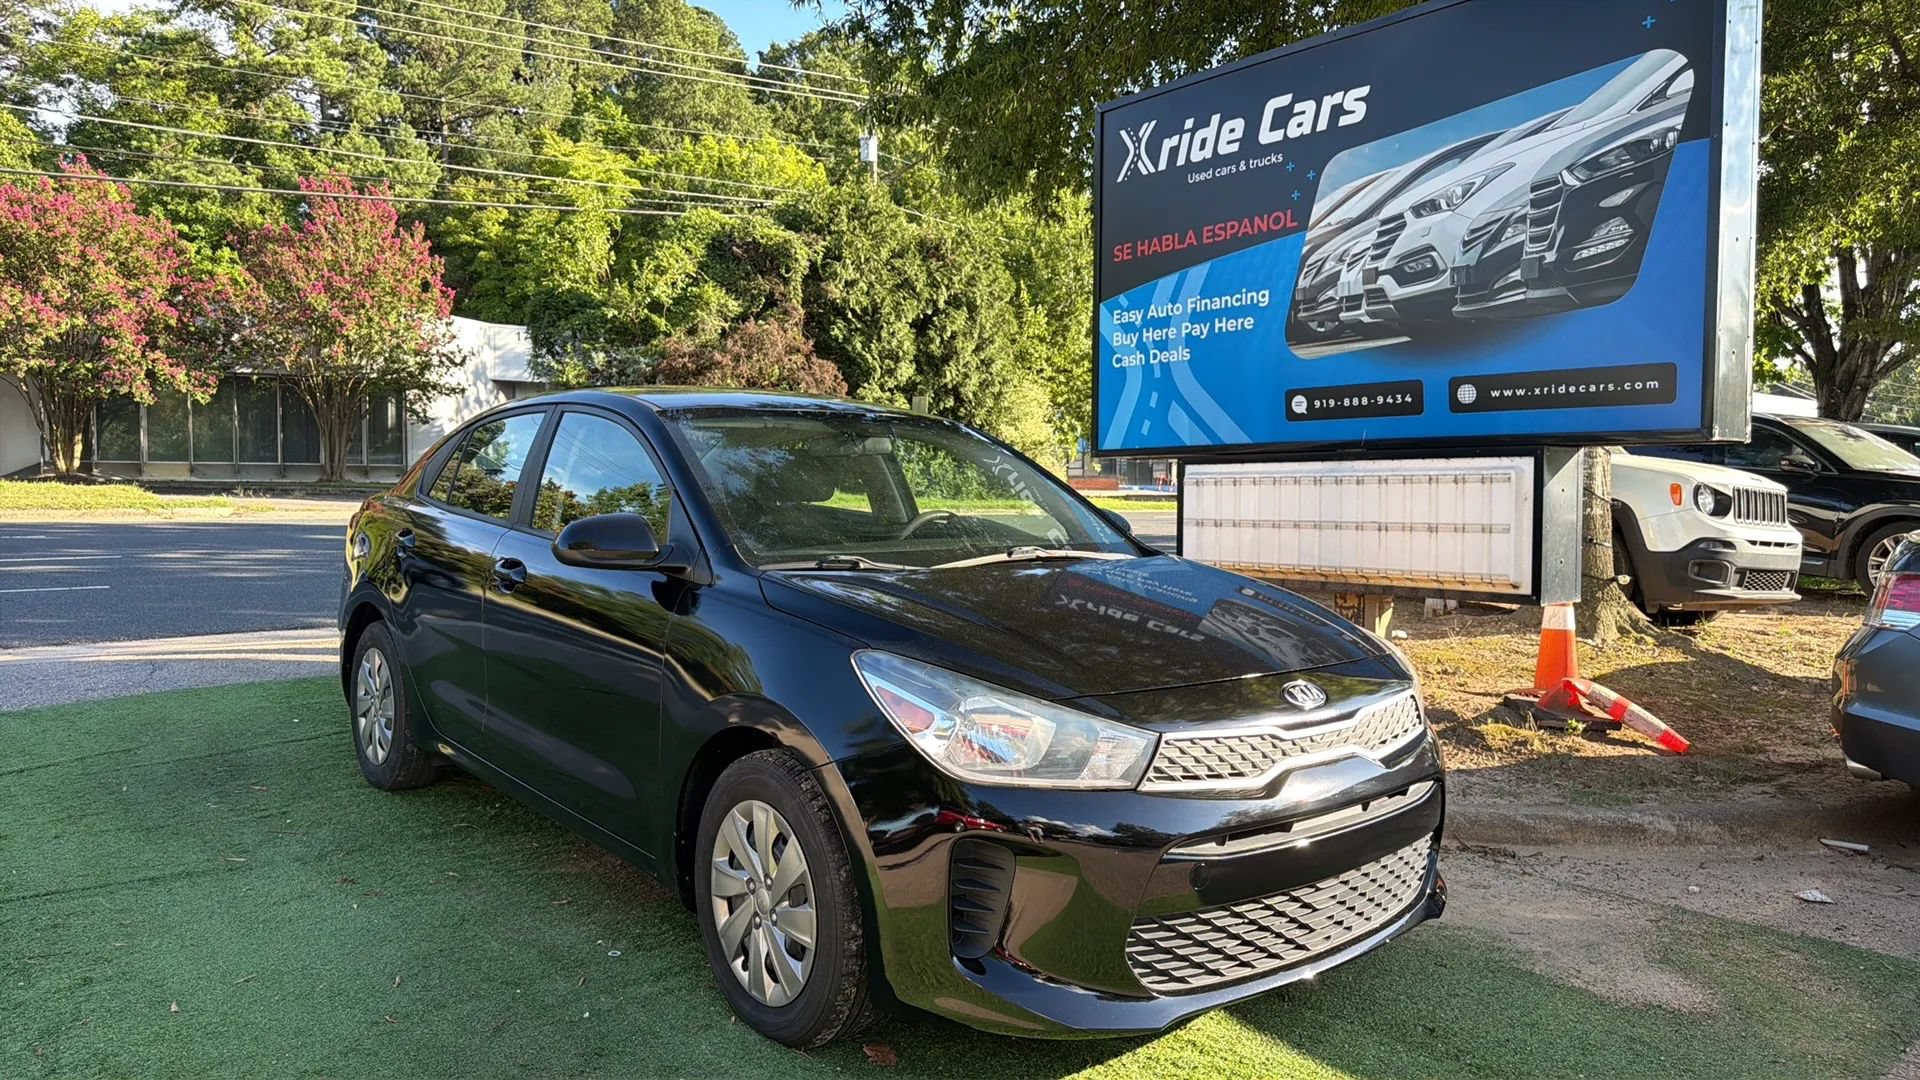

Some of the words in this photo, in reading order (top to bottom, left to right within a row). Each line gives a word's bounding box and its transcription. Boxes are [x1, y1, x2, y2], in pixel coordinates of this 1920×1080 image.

[1117, 112, 1245, 183] Xride
[1258, 85, 1371, 145] Cars
[1187, 167, 1213, 184] Used
[1215, 161, 1237, 178] cars
[1239, 159, 1247, 171] &
[1249, 152, 1283, 168] trucks
[1113, 243, 1133, 262] SE
[1137, 229, 1197, 258] HABLA
[1203, 209, 1298, 244] ESPANOL
[1113, 307, 1143, 327] Easy
[1147, 301, 1183, 320] Auto
[1187, 287, 1270, 313] Financing
[1112, 330, 1139, 347] Buy
[1142, 325, 1177, 343] Here
[1181, 320, 1210, 339] Pay
[1214, 315, 1255, 333] Here
[1112, 351, 1145, 369] Cash
[1149, 346, 1191, 364] Deals
[1313, 393, 1413, 409] 919-888-9434
[1490, 379, 1660, 399] www.xridecars.com
[1288, 684, 1324, 702] KIA
